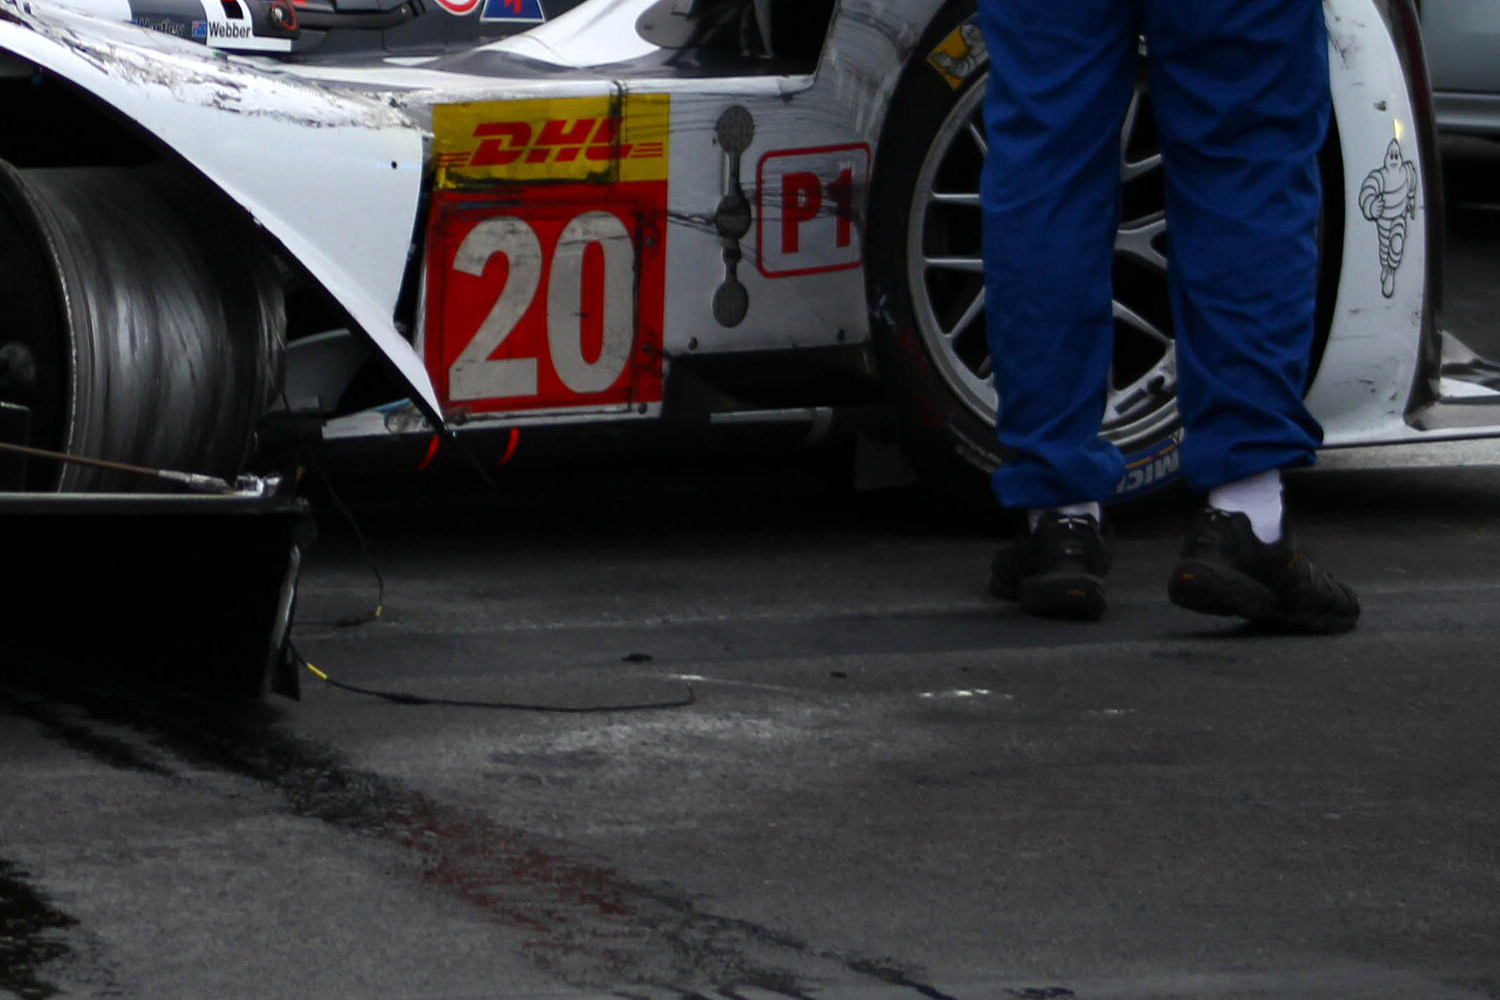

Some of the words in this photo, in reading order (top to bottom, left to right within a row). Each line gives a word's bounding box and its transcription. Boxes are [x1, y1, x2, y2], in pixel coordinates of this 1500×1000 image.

[208, 21, 251, 38] Webber
[469, 116, 636, 168] DHL
[780, 166, 854, 254] P1
[447, 209, 637, 402] 20
